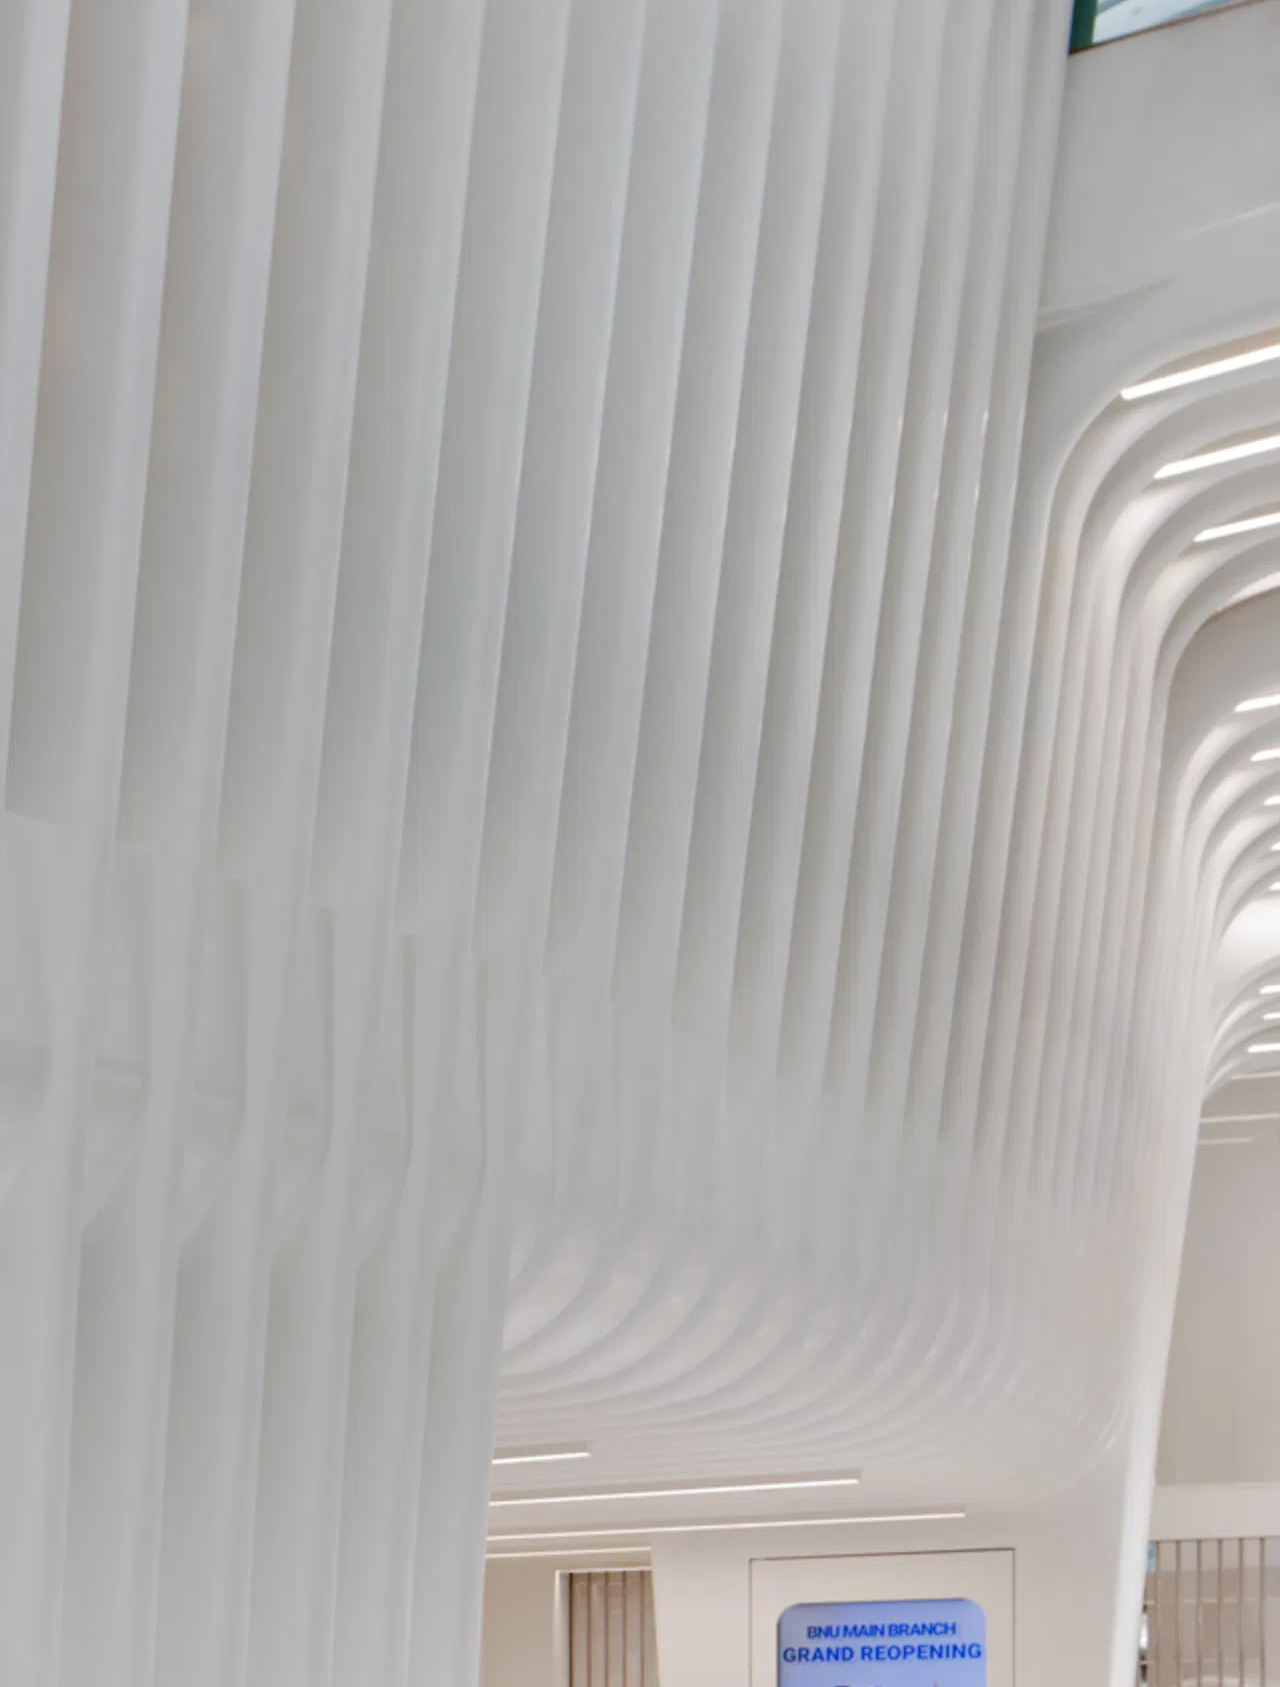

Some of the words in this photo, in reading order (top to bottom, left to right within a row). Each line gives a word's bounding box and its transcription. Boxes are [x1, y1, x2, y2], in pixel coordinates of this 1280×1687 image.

[807, 1625, 840, 1638] BNU
[843, 1624, 885, 1637] MAIN
[888, 1621, 957, 1636] BRANCH
[783, 1646, 854, 1662] GRAND
[860, 1643, 982, 1661] REOPENING
